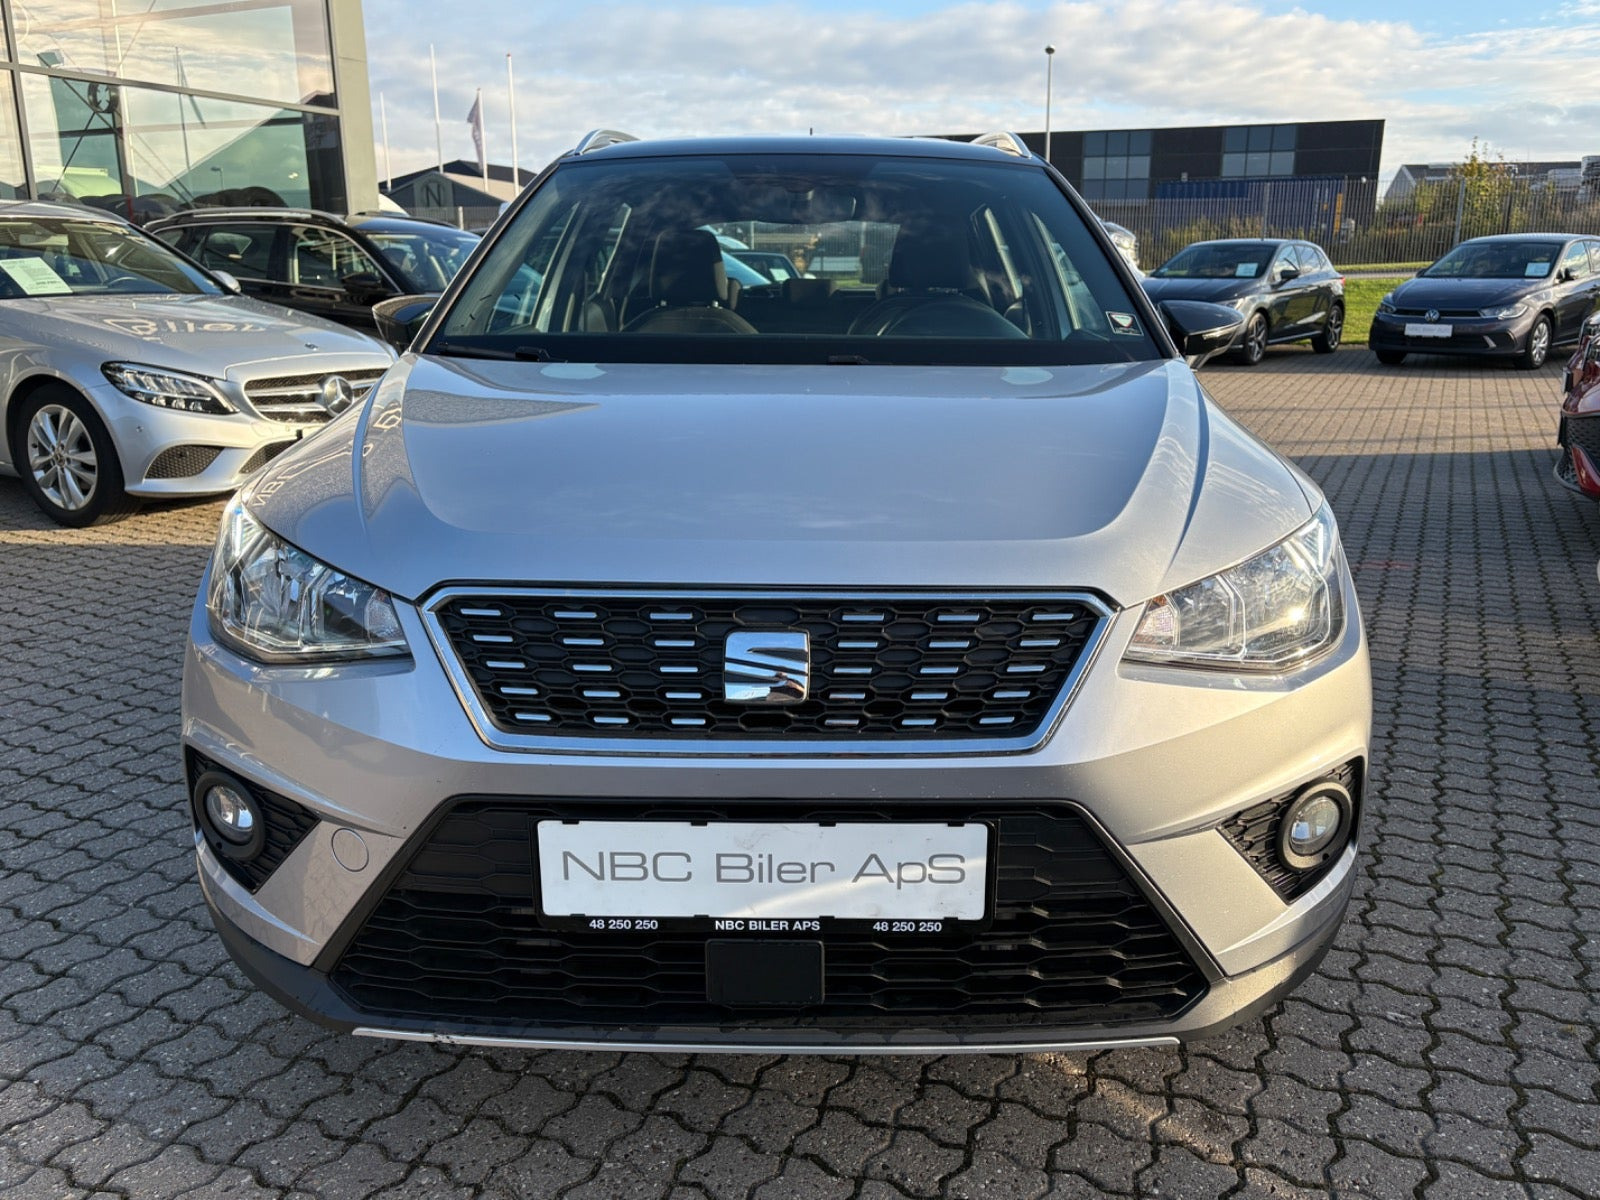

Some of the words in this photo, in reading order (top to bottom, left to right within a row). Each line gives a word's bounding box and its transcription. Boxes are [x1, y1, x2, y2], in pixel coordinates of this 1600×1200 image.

[562, 850, 693, 883] NBC
[715, 852, 836, 884] Biler
[852, 853, 966, 891] ApS
[589, 919, 605, 930] 48
[608, 919, 632, 930] 250
[635, 919, 659, 931] 250
[715, 920, 745, 931] NBC
[748, 920, 789, 931] BILER
[792, 920, 821, 931] APS
[872, 921, 889, 932] 48
[892, 921, 916, 932] 250
[918, 921, 942, 932] 250
